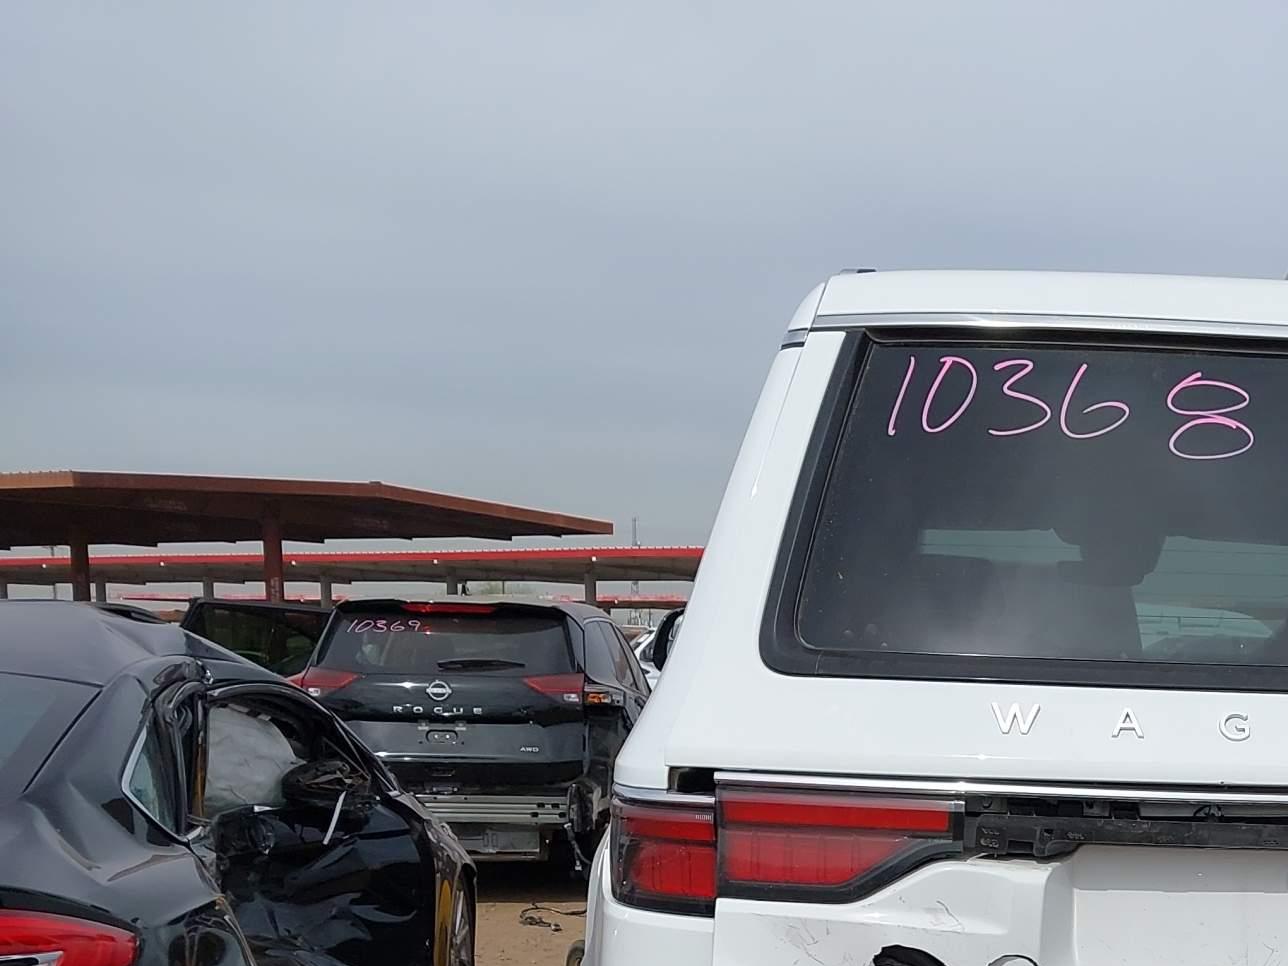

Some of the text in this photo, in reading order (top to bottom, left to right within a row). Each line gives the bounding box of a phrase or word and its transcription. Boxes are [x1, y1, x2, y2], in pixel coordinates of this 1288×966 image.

[886, 355, 1255, 460] 10368
[346, 618, 422, 633] 10369
[393, 705, 484, 714] ROGUE
